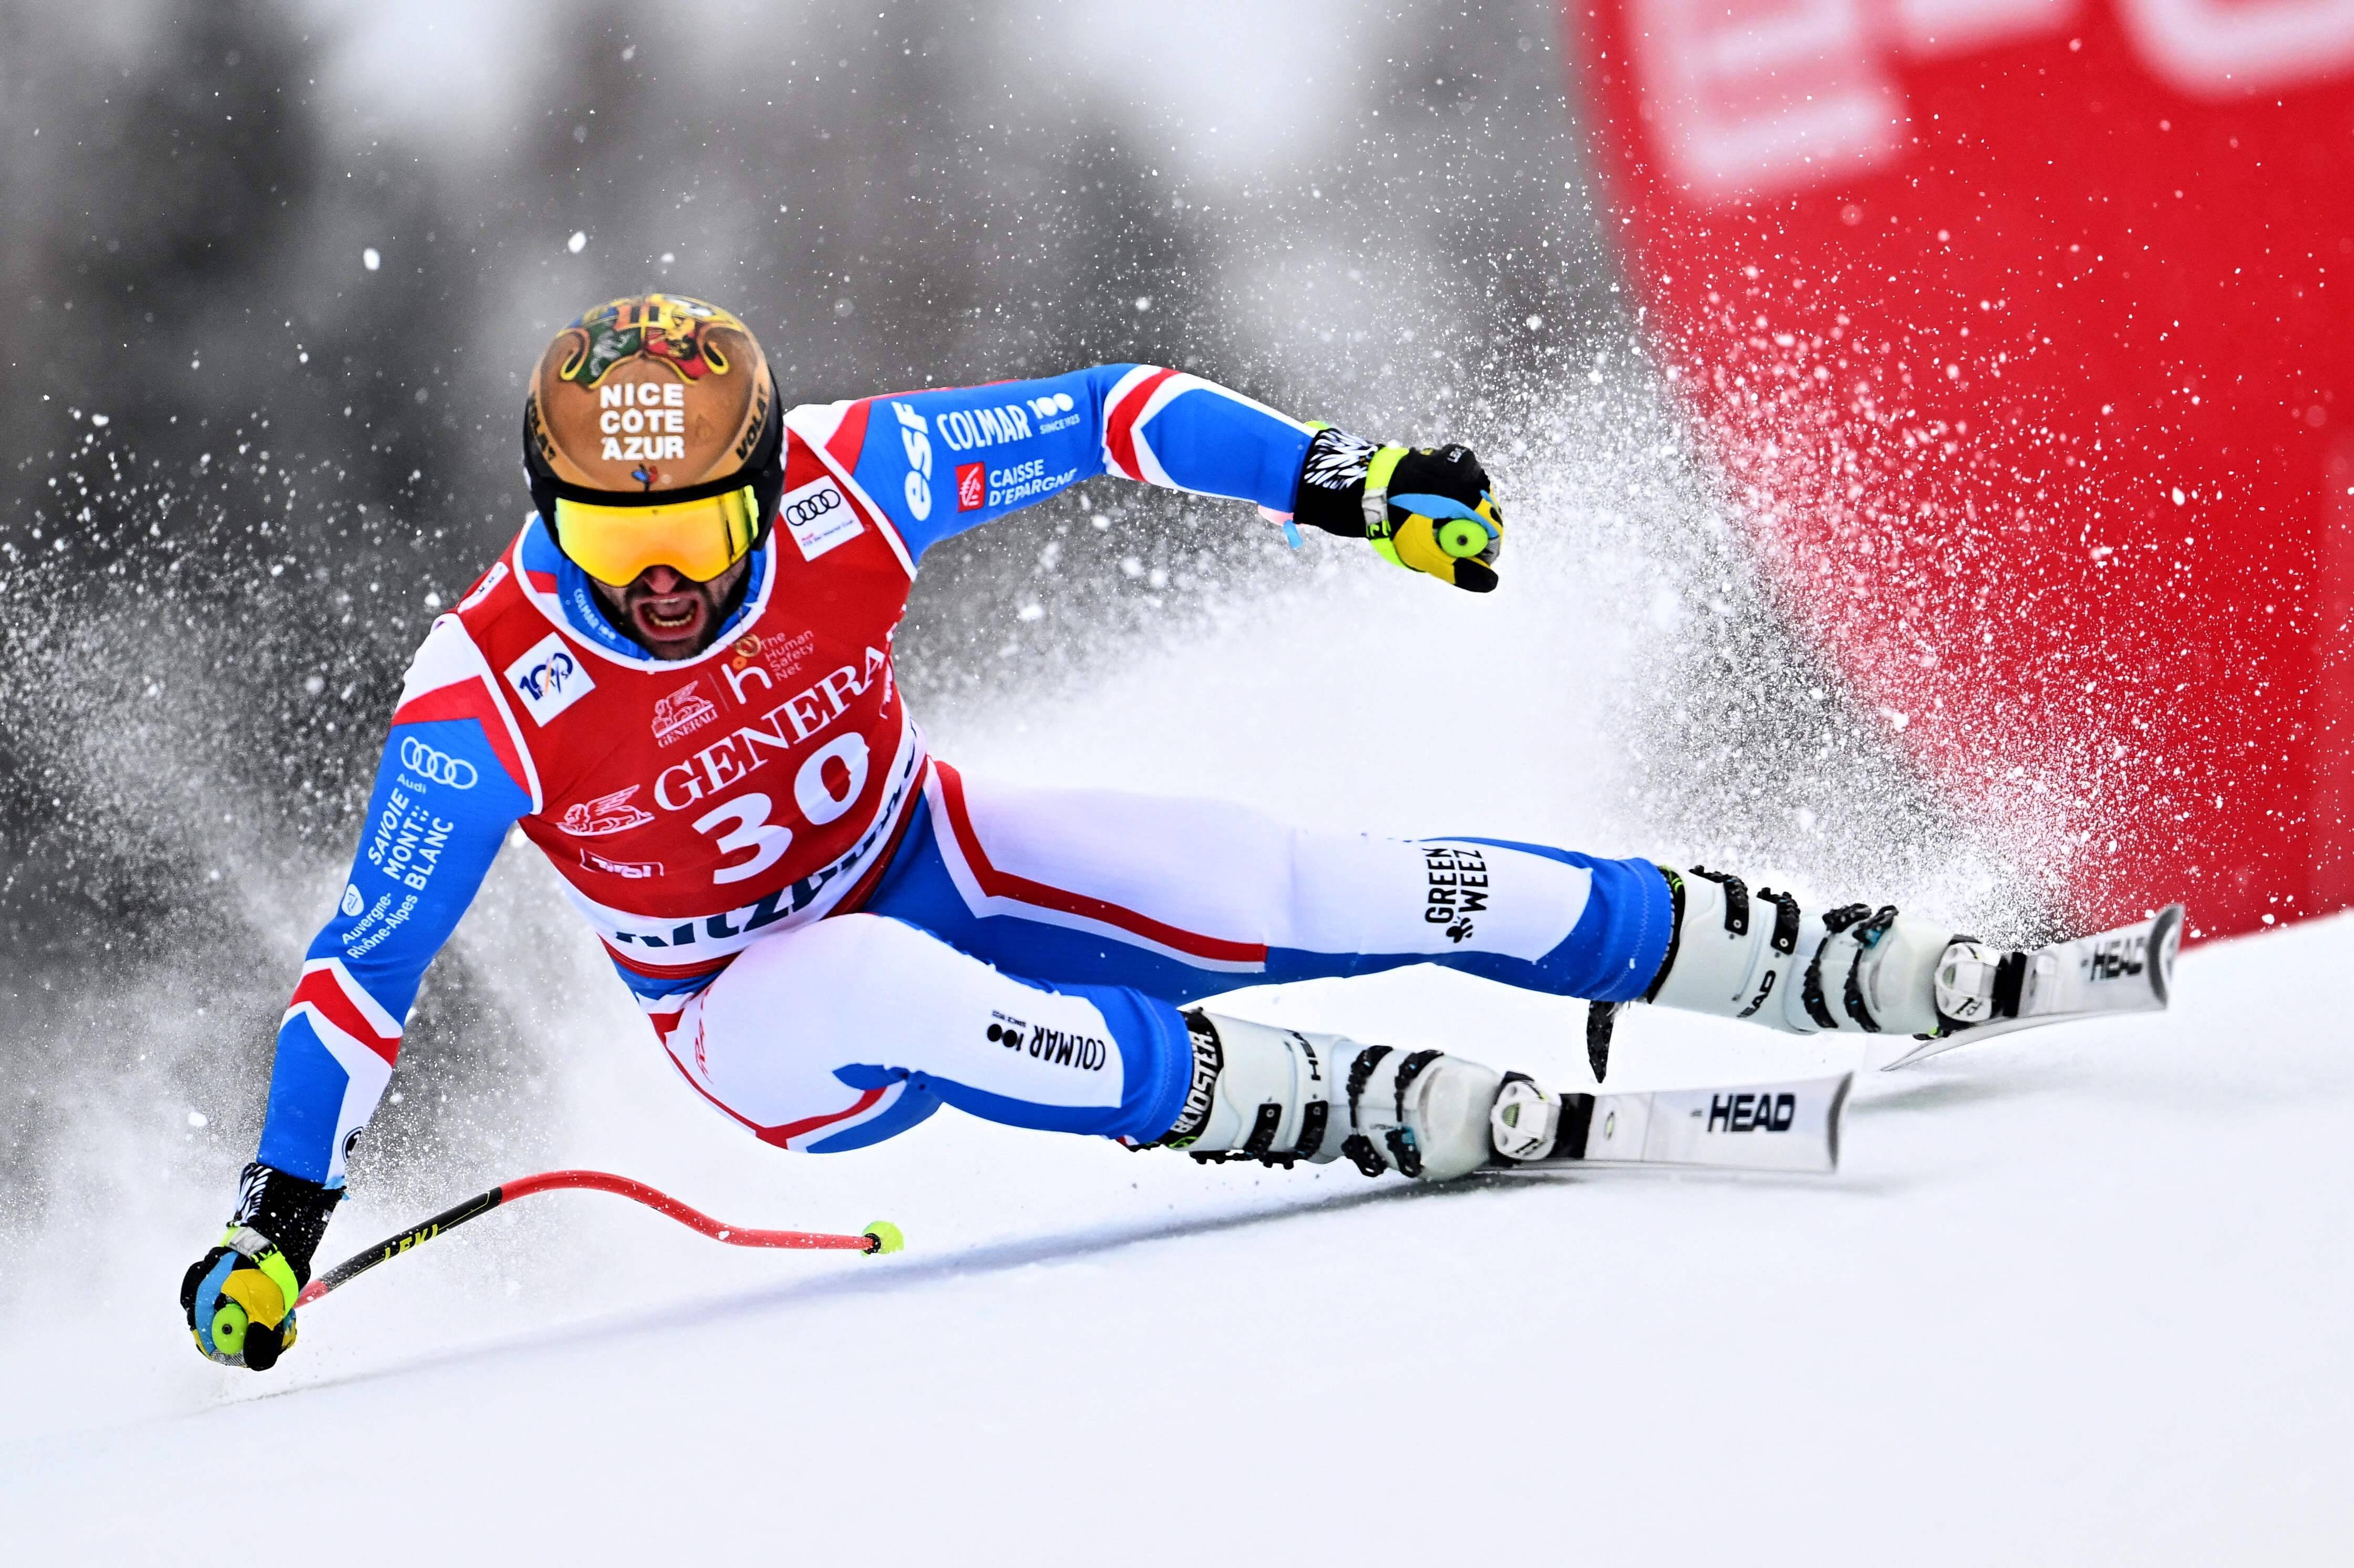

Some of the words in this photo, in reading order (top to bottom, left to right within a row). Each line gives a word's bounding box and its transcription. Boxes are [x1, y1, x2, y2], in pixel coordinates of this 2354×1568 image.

[600, 382, 685, 409] NICE
[936, 404, 1033, 451] COLMAR
[1026, 393, 1075, 420] 100
[989, 458, 1045, 488] CAISSE
[573, 588, 600, 629] COLMAR
[760, 632, 786, 651] The
[765, 630, 814, 662] Human
[769, 643, 814, 672] Safety
[775, 662, 802, 682] Net
[658, 708, 718, 748] GENERALI
[396, 773, 427, 795] Audi
[368, 788, 409, 865] SAVOIE
[692, 731, 870, 885] 30
[382, 817, 424, 880] MONT
[404, 817, 453, 891] BLANC
[1422, 848, 1457, 923] GREEN
[1452, 849, 1488, 913] WEEZ
[342, 893, 391, 945] Auvergne-
[346, 894, 418, 959] Rhône-Alpes
[987, 1024, 1024, 1051] 100
[1029, 1025, 1106, 1071] COLMAR
[1170, 1030, 1218, 1134] BOOSTER
[1707, 1092, 1795, 1132] HEAD
[385, 1223, 438, 1261] LEKI
